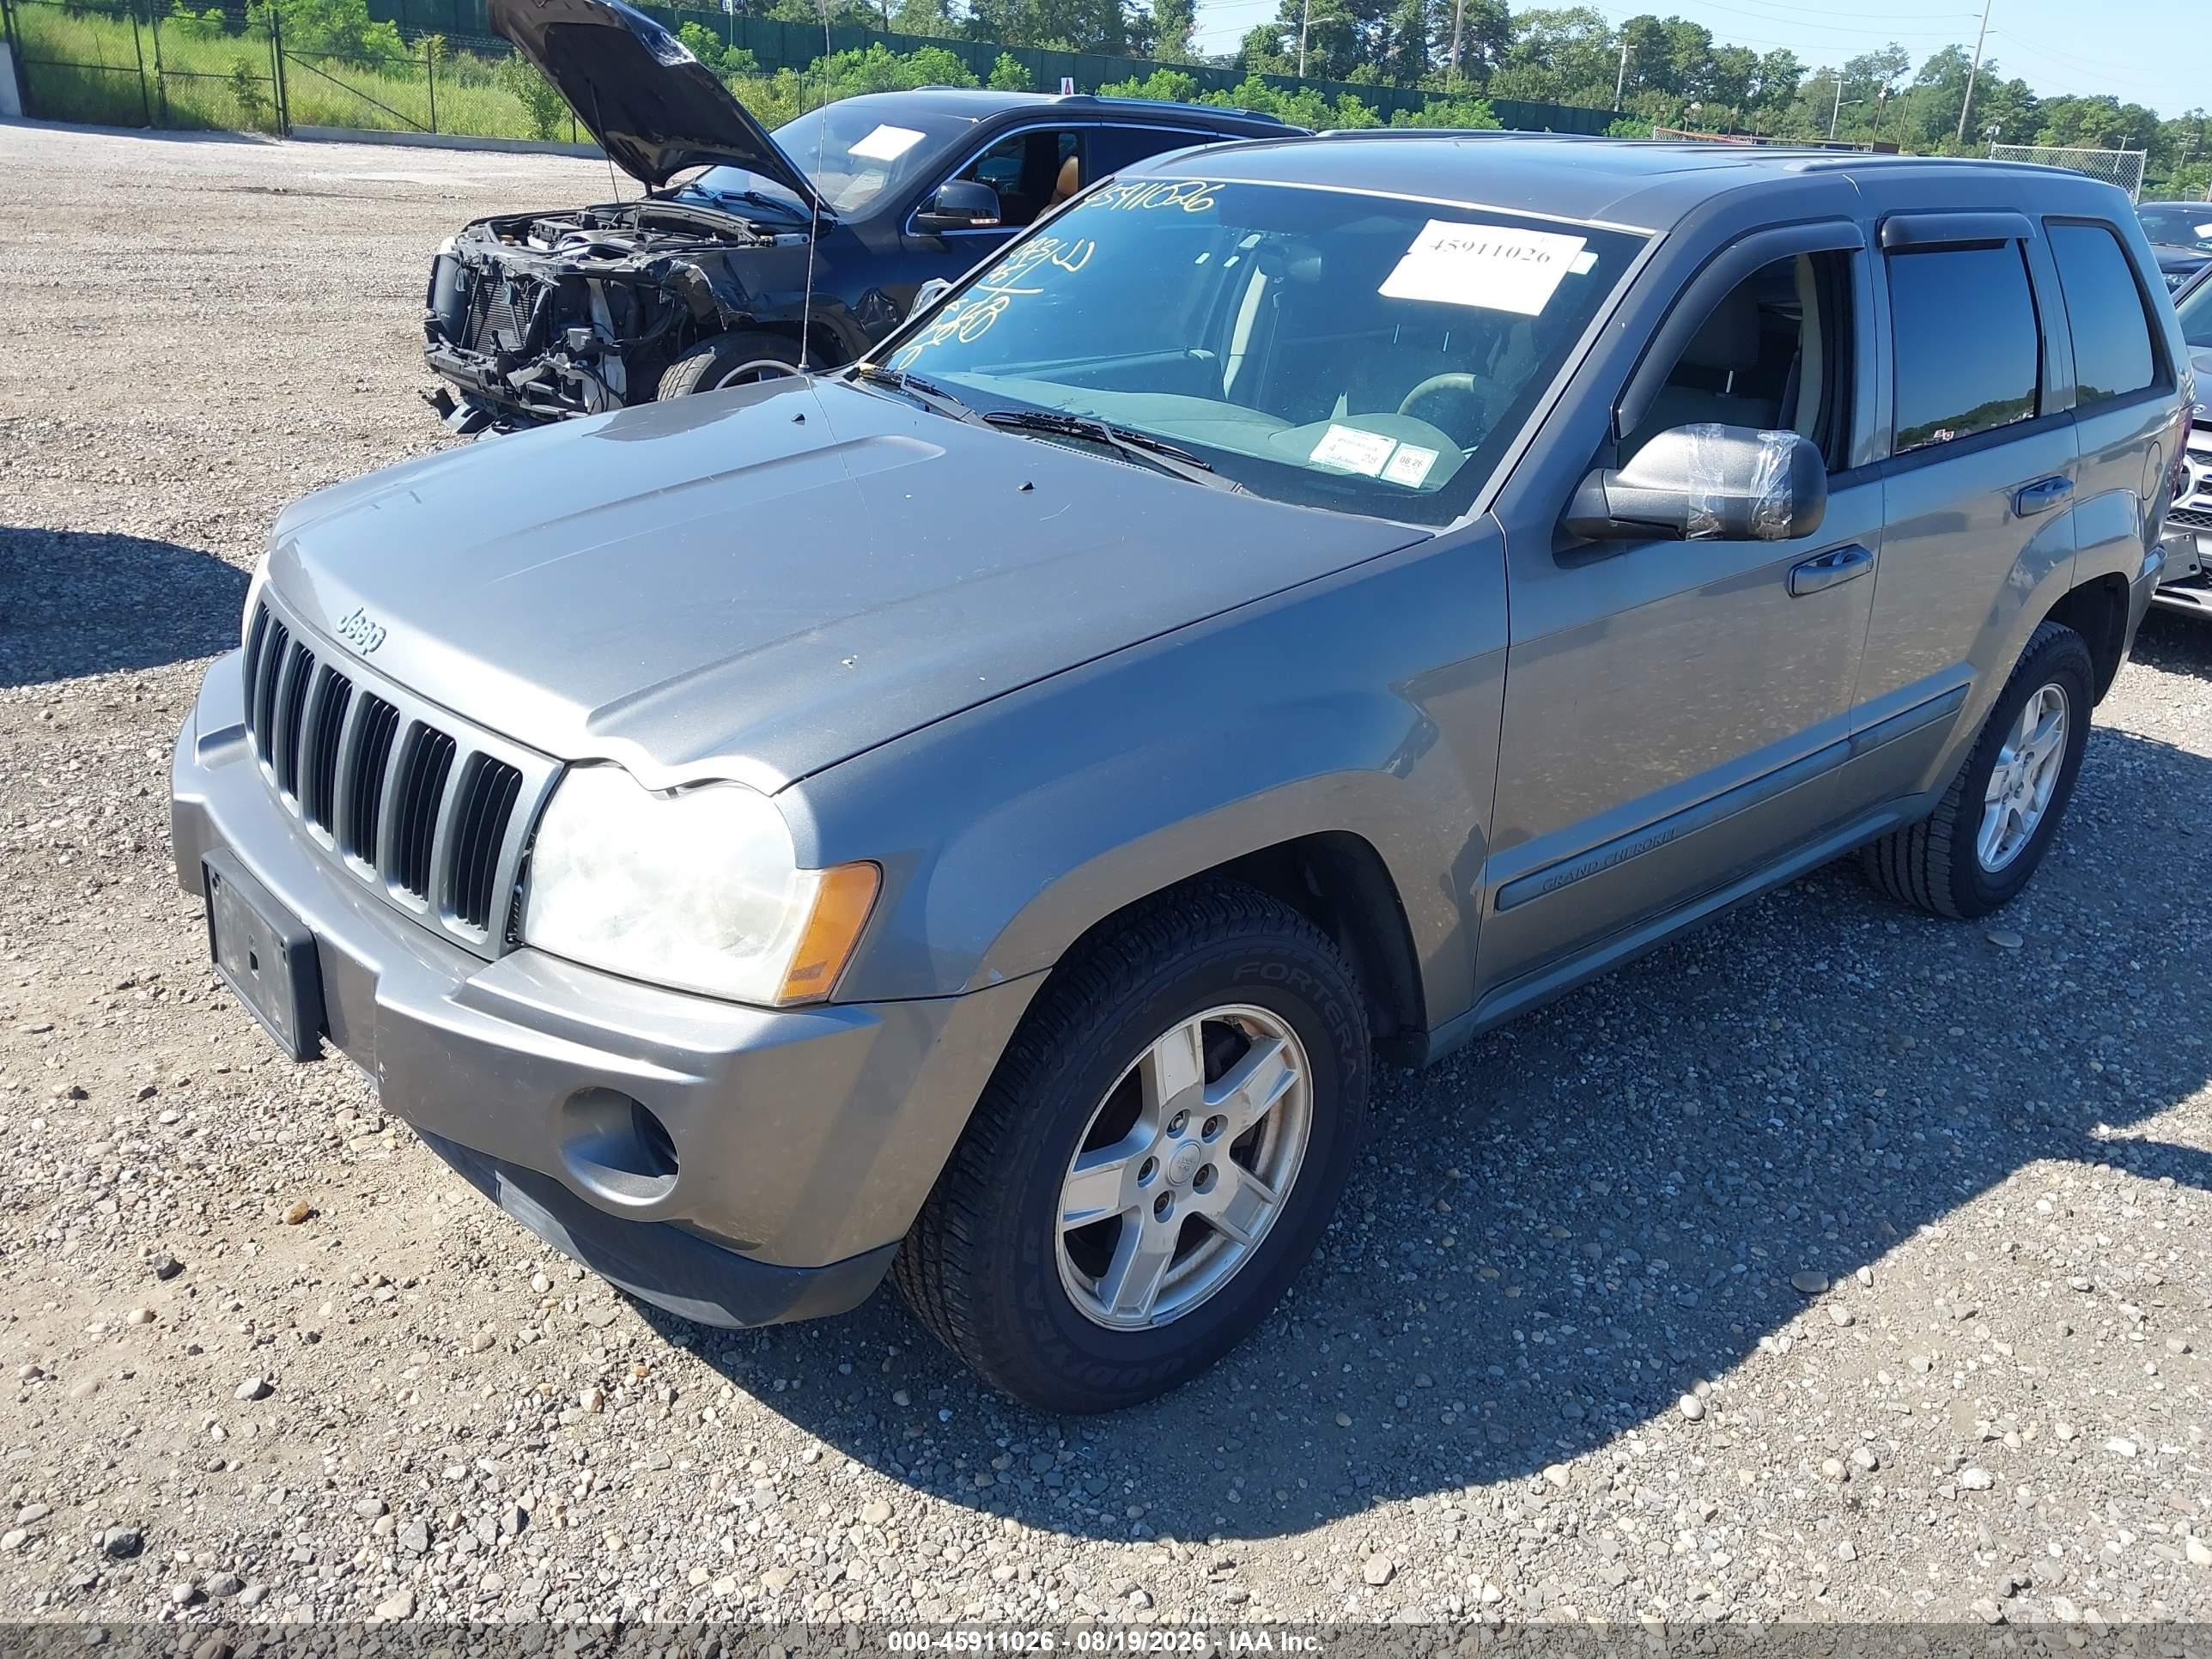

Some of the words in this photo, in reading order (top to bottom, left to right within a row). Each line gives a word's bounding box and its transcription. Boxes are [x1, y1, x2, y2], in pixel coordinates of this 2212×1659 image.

[1074, 179, 1226, 213] 45911026
[1429, 239, 1551, 264] 45911026
[336, 605, 387, 656] Jeep
[1542, 860, 1599, 891] GRAND
[1603, 829, 1675, 866] CHEROKEE
[1231, 961, 1358, 1088] FORTERA
